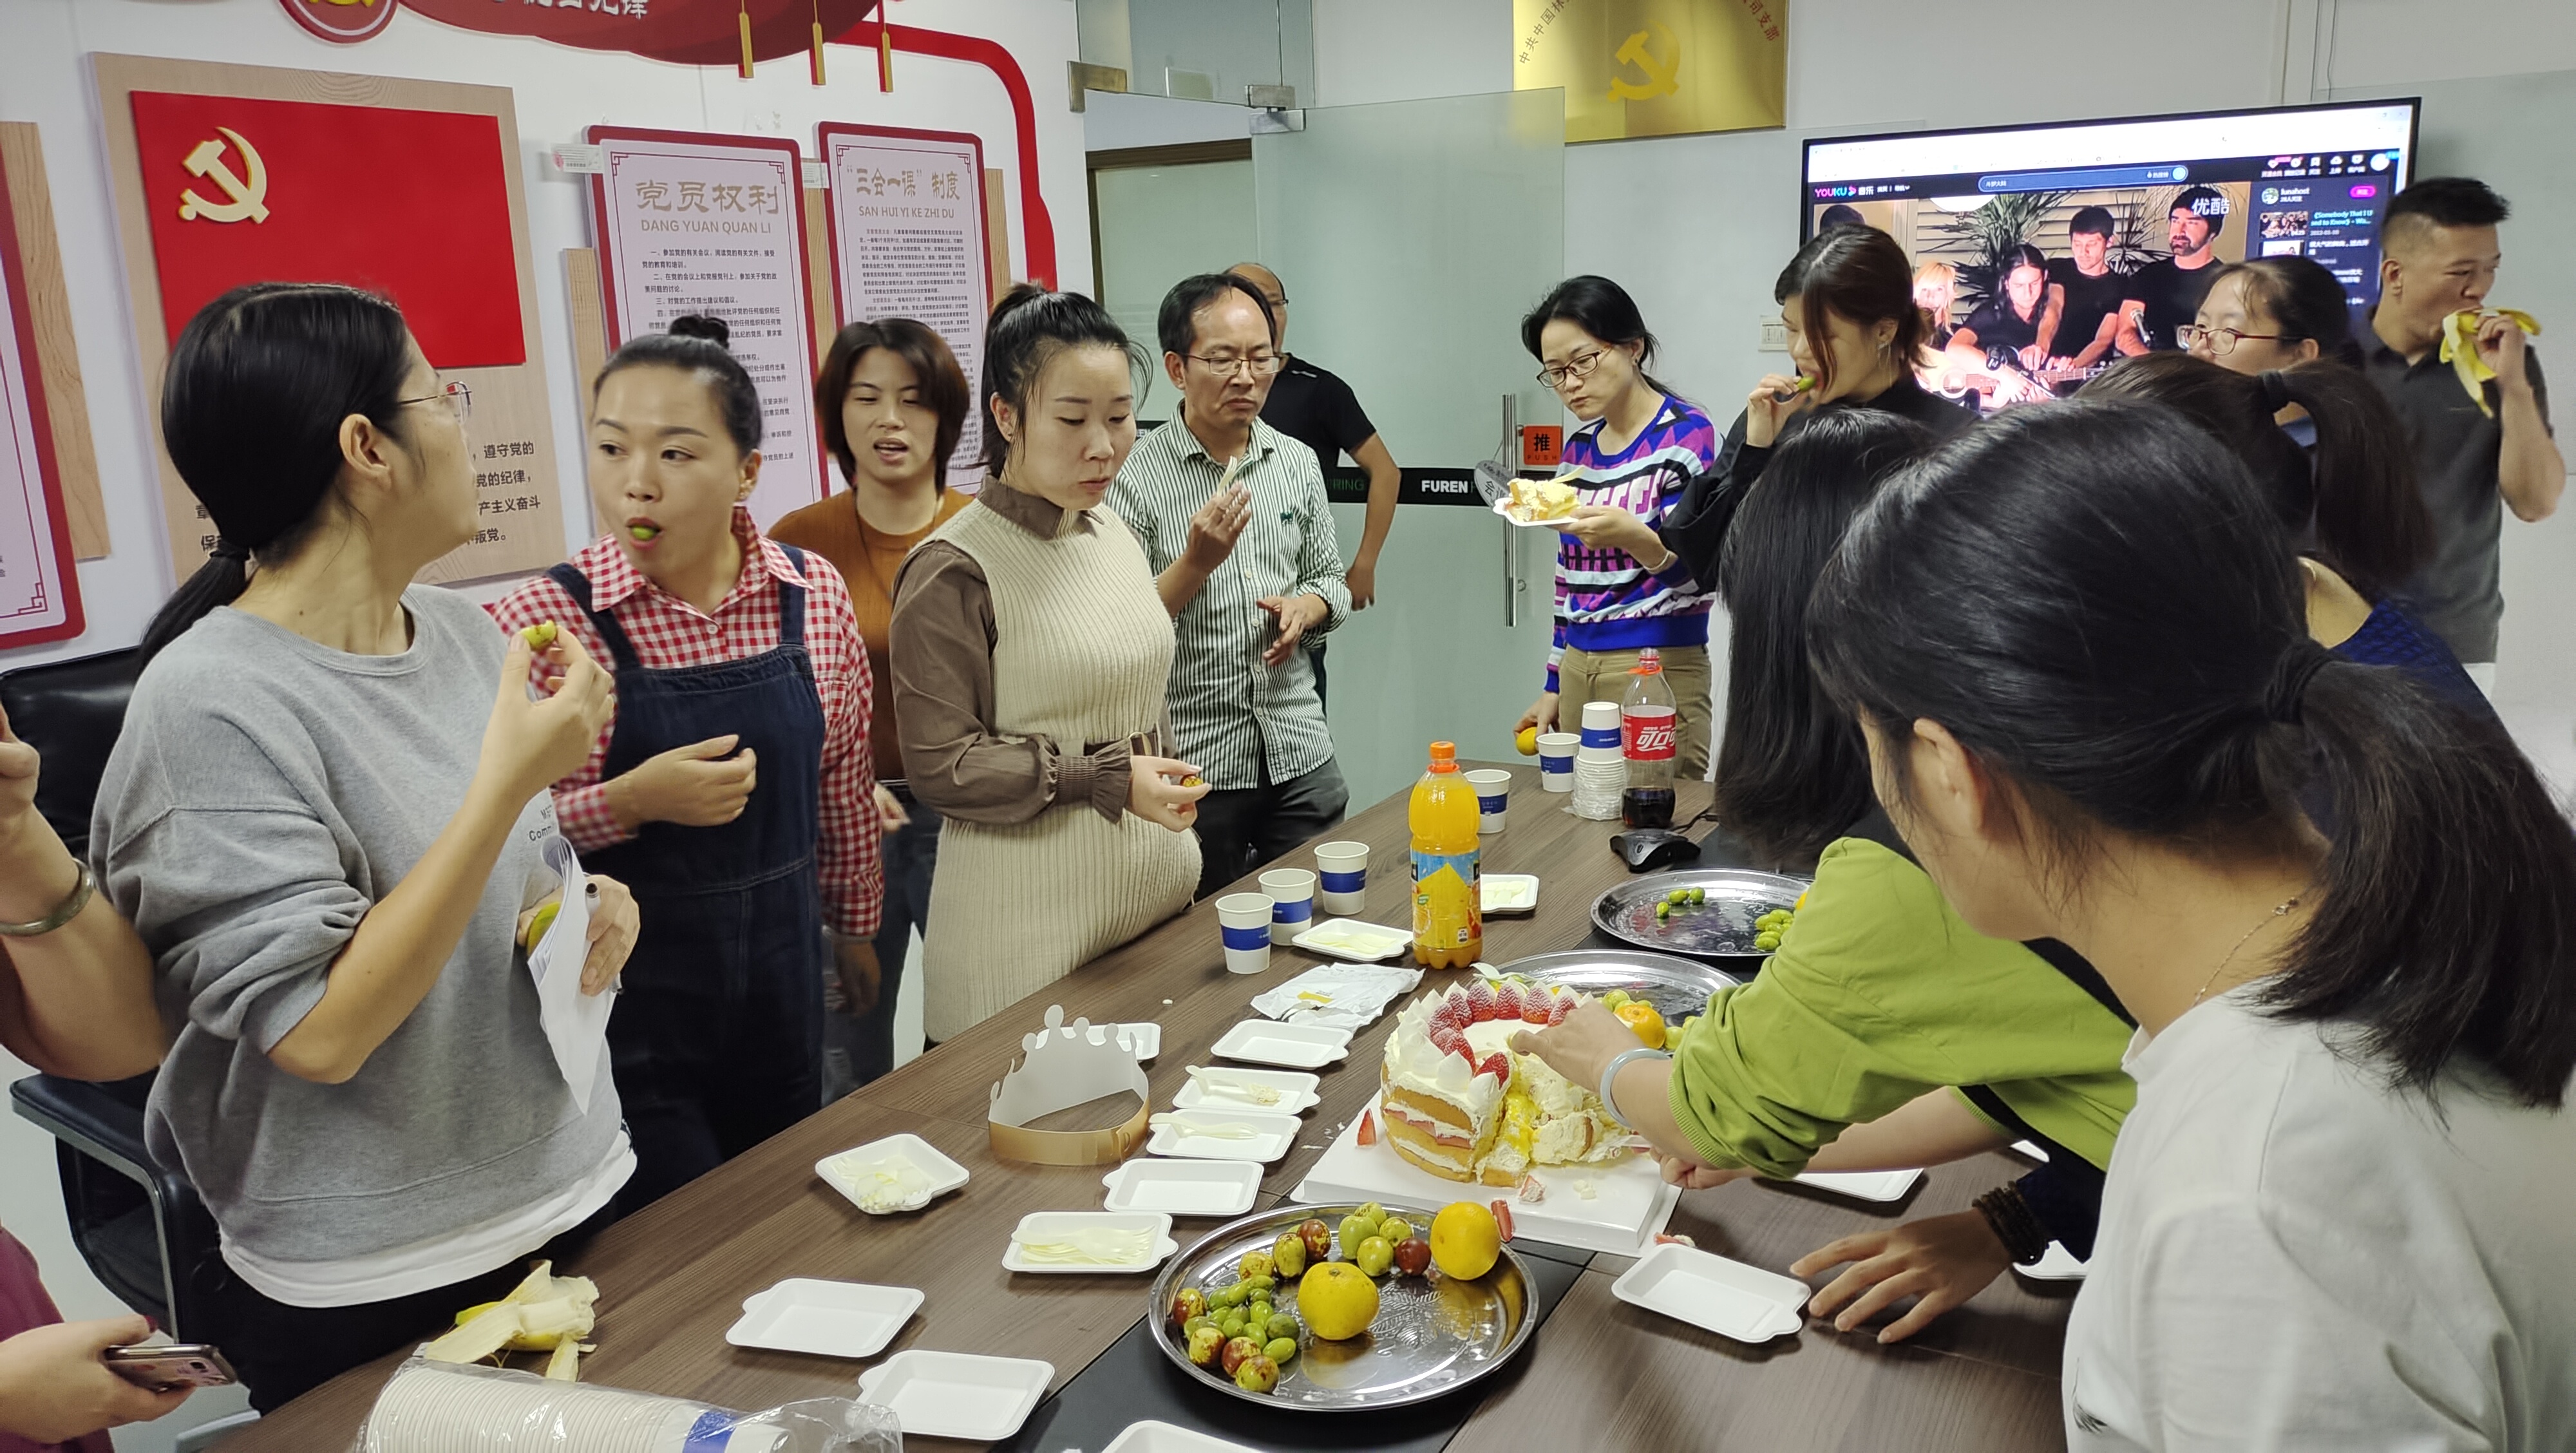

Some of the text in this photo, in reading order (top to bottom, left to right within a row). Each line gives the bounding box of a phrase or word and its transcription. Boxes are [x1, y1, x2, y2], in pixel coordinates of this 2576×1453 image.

[636, 179, 779, 215] 党员权利
[1815, 187, 1847, 198] YOUKU
[858, 205, 954, 218] SAN HUI YI KE ZHI DU
[2192, 197, 2230, 216] 优酷
[641, 220, 771, 234] DANG YUAN QUAN LI
[1533, 433, 1551, 451] 推
[1421, 480, 1468, 493] FUREN
[478, 495, 541, 516] 产主义奋斗
